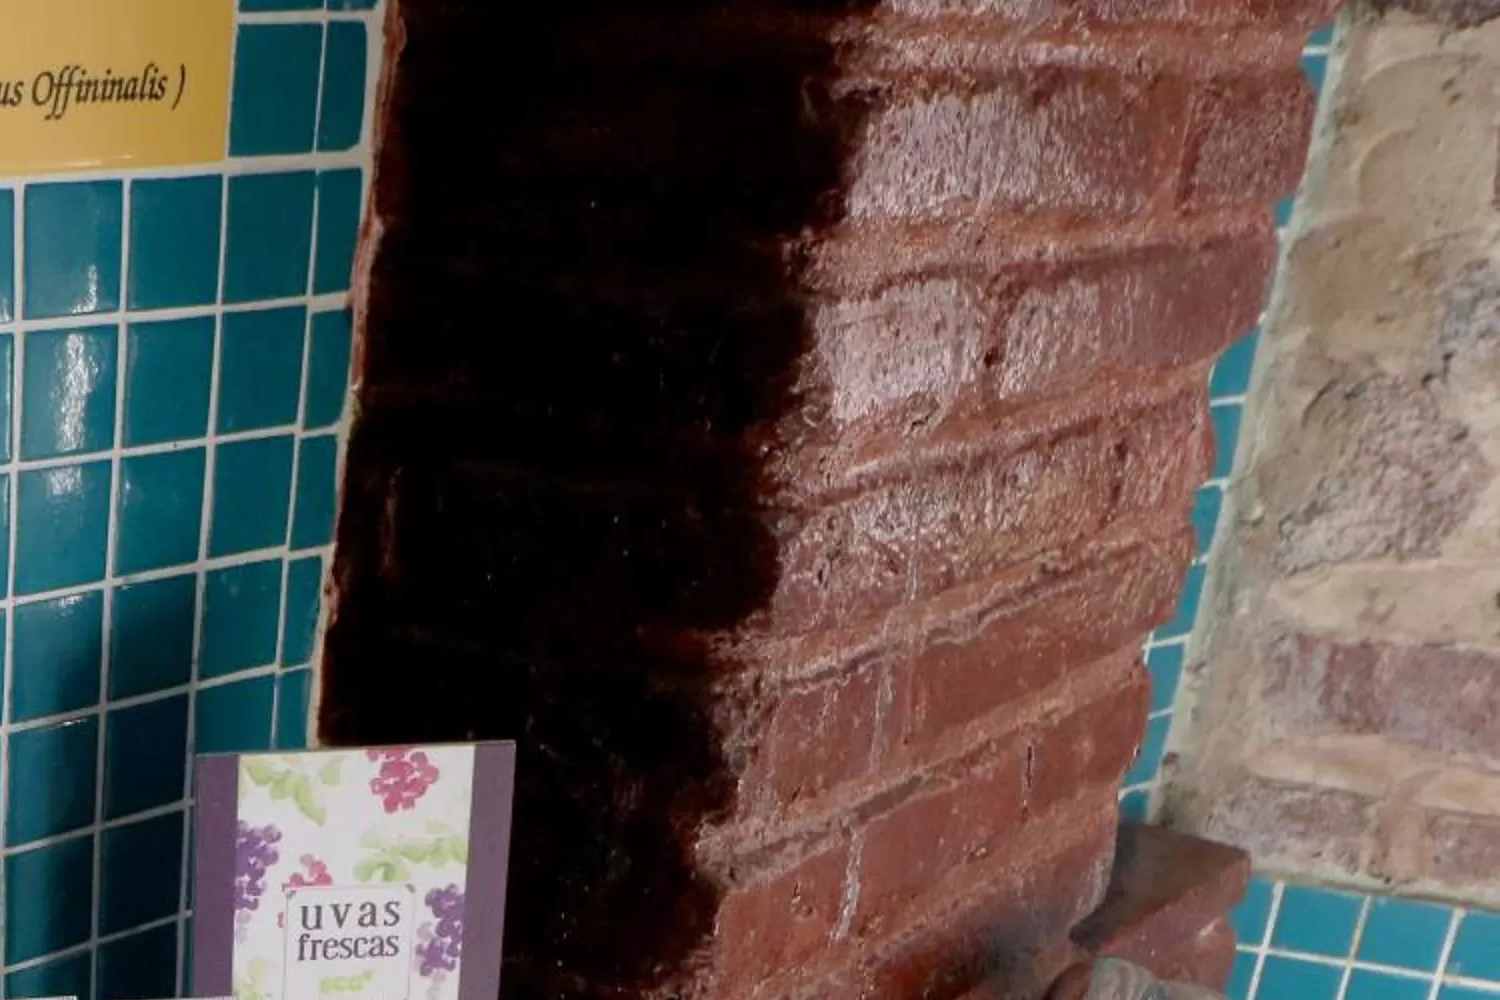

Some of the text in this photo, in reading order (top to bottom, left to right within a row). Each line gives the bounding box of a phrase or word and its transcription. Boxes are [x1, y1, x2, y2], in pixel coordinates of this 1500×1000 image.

[31, 63, 169, 120] Offininalis
[300, 900, 401, 931] uvas
[297, 933, 400, 961] frescas
